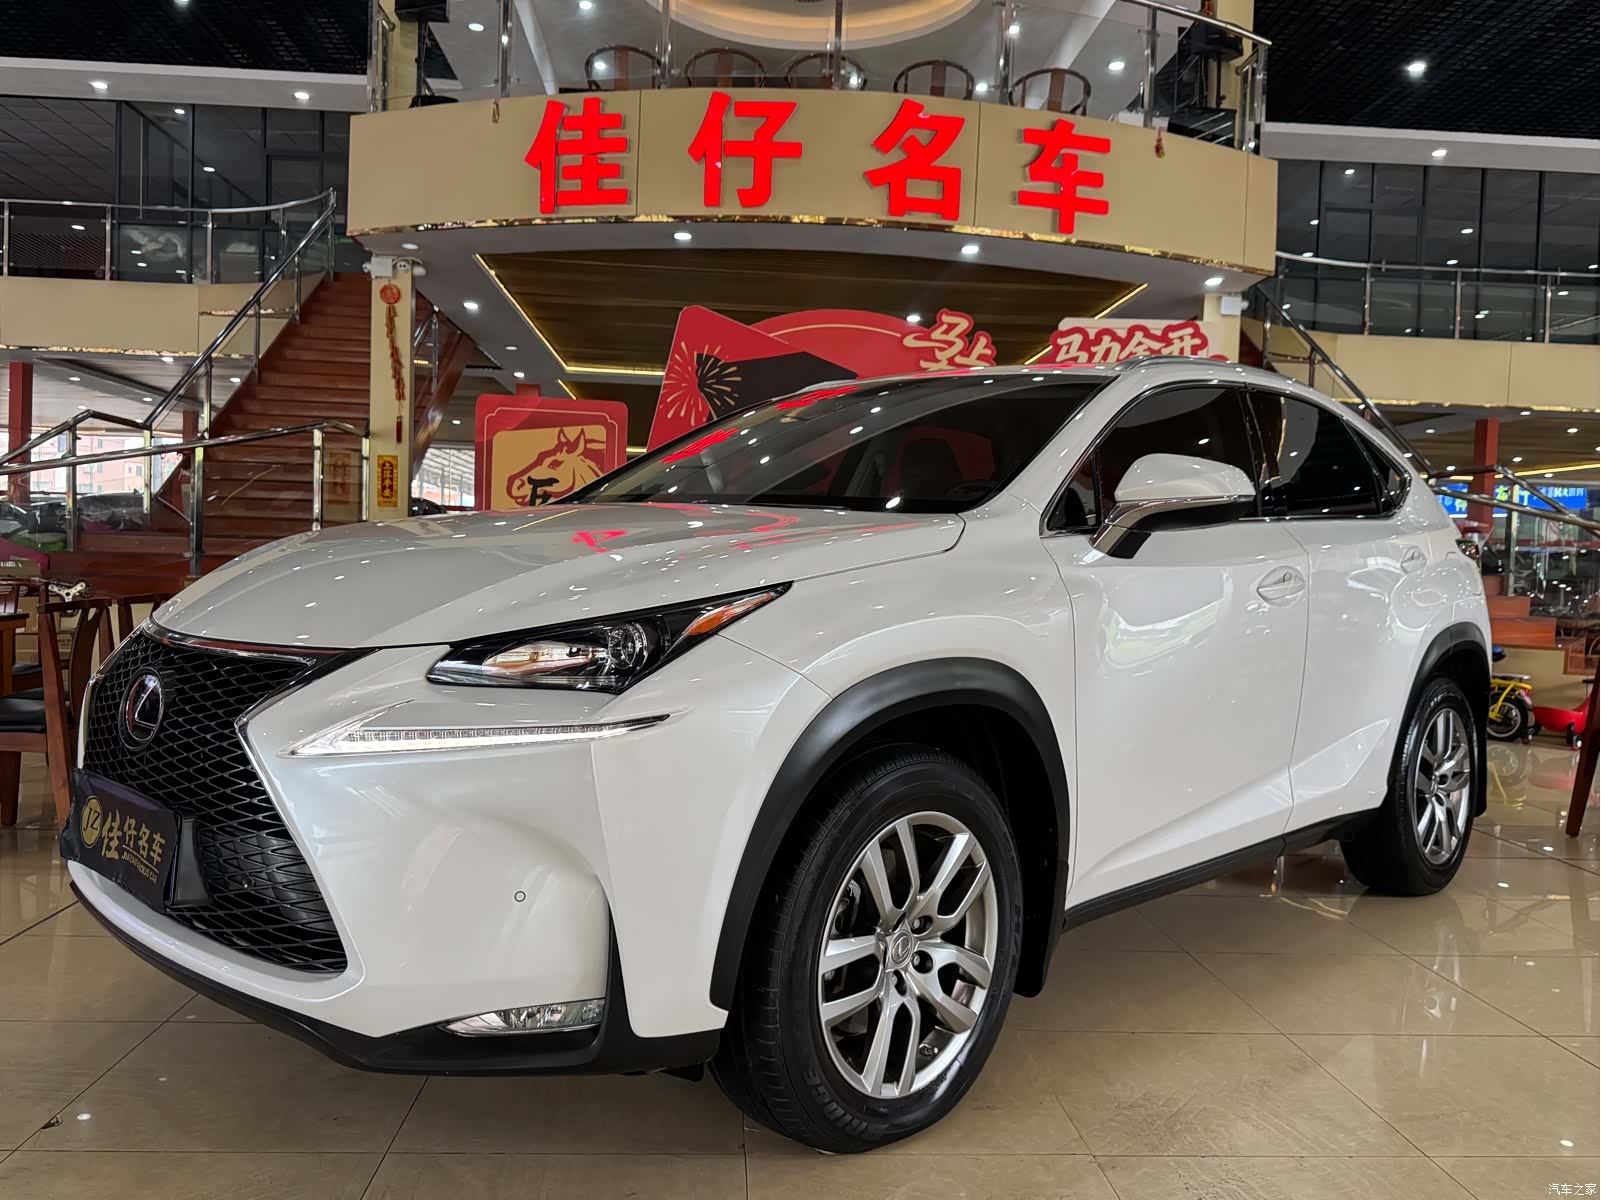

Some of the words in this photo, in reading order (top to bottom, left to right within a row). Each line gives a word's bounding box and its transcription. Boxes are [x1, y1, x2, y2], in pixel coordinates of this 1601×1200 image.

[524, 90, 1112, 235] 佳仔名车
[83, 808, 100, 832] JZ
[101, 809, 166, 866] 佳仔名车
